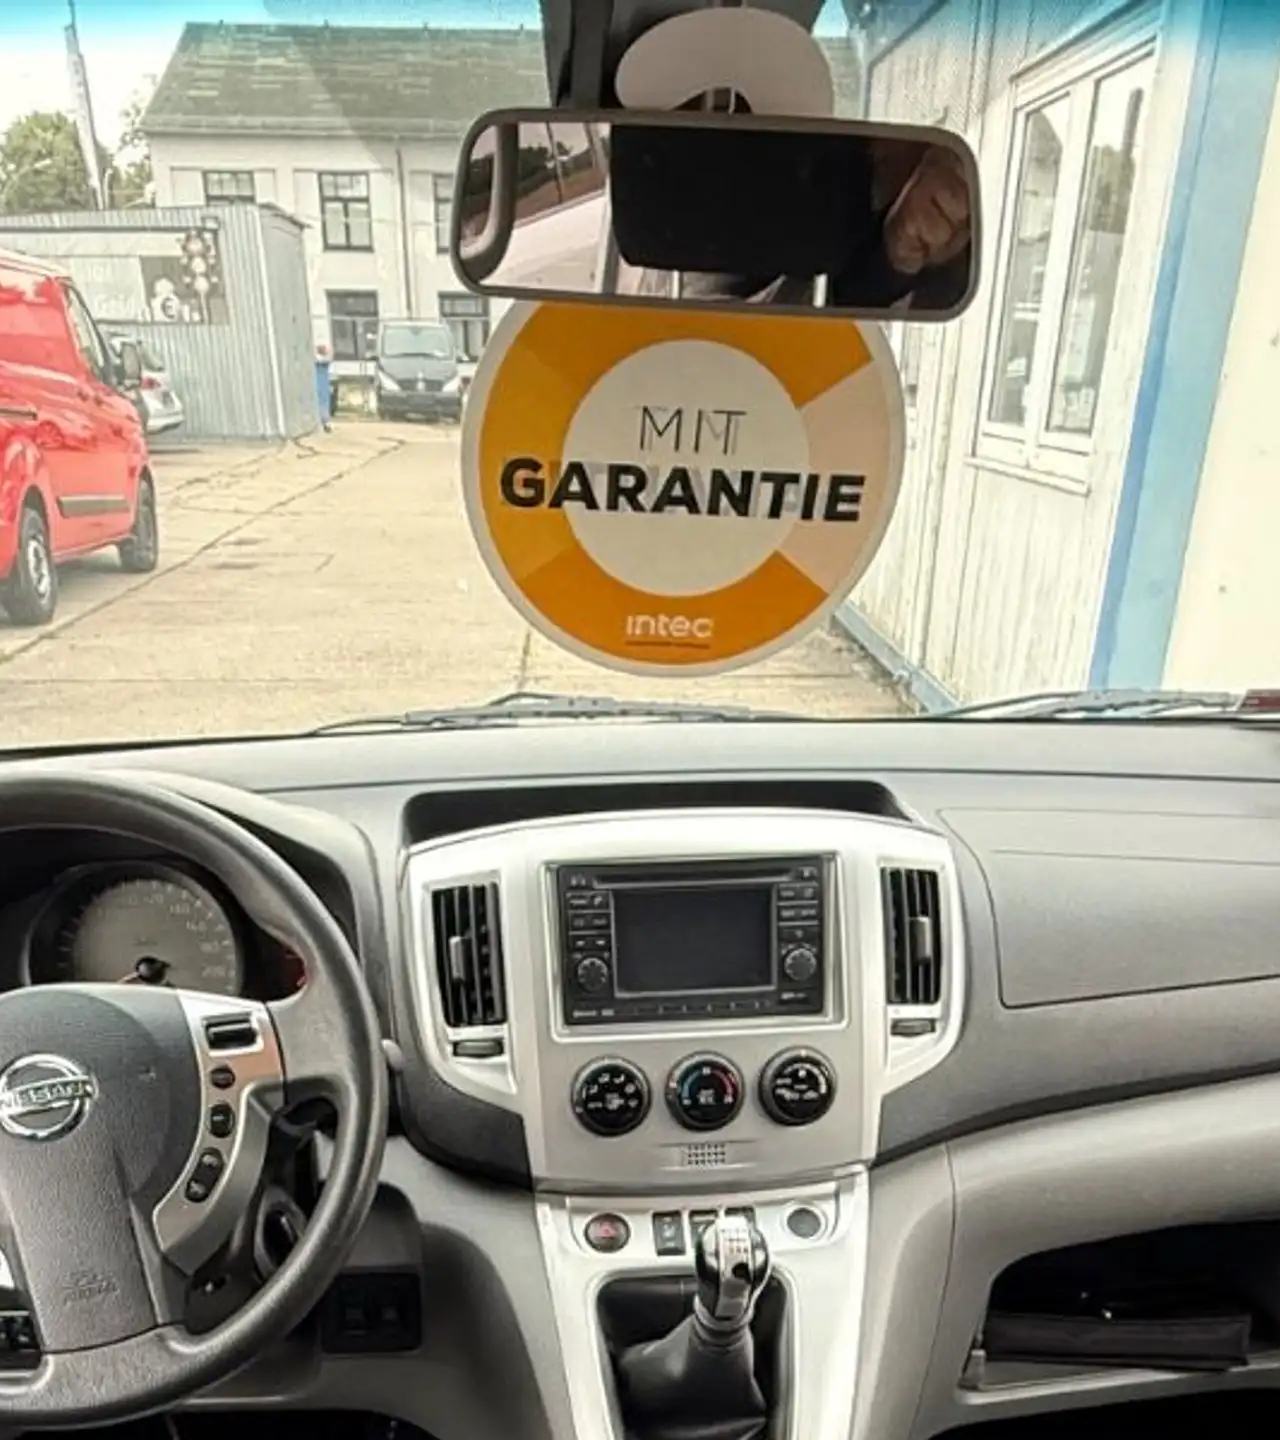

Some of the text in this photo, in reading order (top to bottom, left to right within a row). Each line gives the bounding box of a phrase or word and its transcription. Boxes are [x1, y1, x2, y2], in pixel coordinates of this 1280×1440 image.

[639, 405, 747, 455] MIT
[500, 457, 867, 522] GARANTIE
[626, 613, 714, 640] intec
